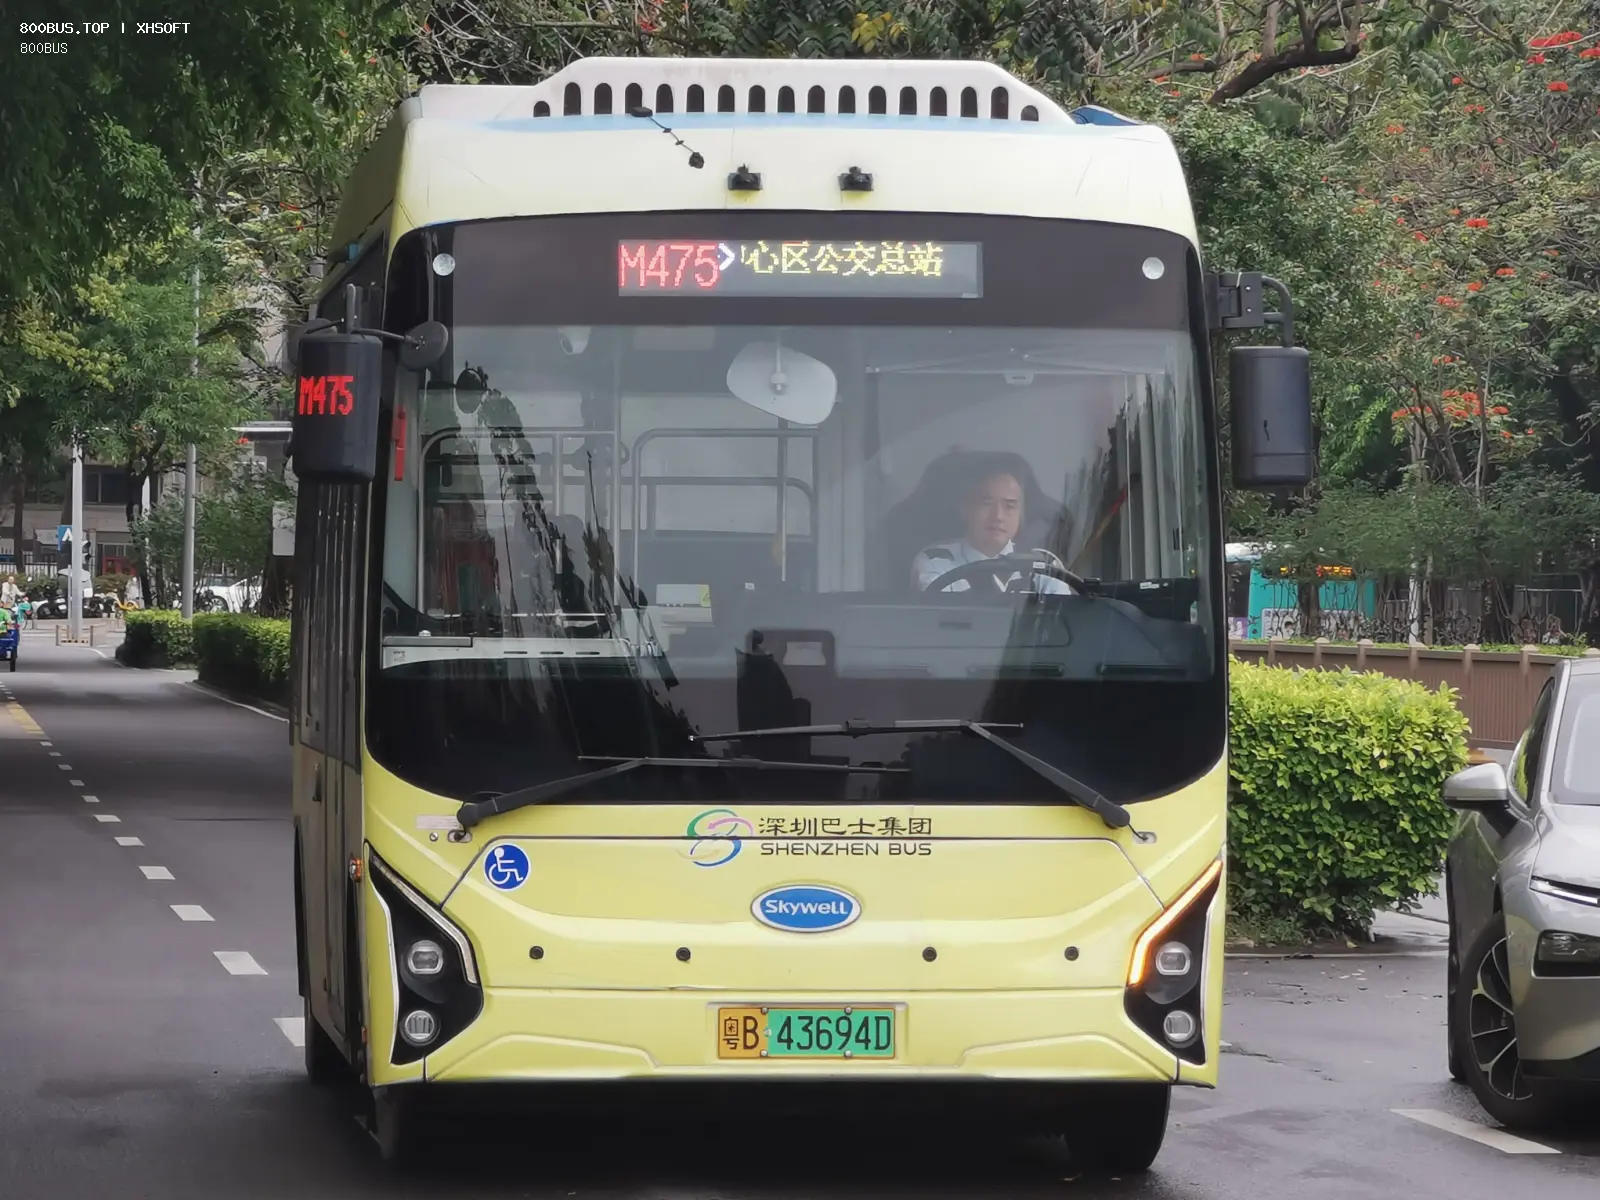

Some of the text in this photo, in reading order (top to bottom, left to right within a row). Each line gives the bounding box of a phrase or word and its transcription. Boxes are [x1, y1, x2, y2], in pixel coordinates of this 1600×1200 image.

[618, 241, 720, 289] M475
[741, 241, 944, 276] 心区公交总站
[299, 375, 354, 415] M475
[759, 817, 932, 836] 深圳巴士集团
[760, 843, 932, 856] SHENZHEN BUS
[765, 899, 848, 916] Skywell
[777, 1015, 891, 1050] 43694D
